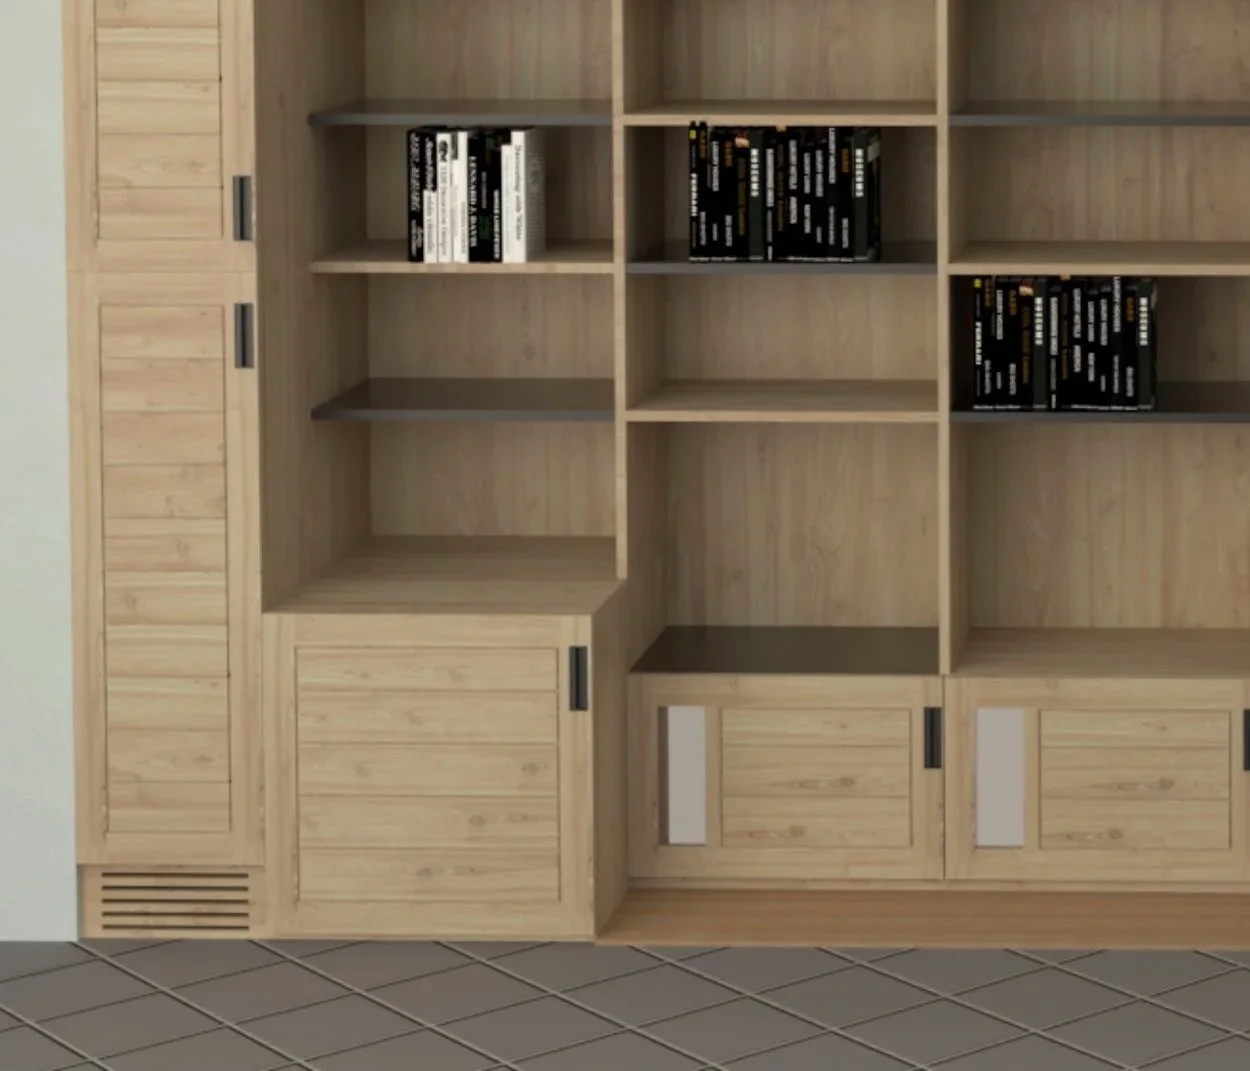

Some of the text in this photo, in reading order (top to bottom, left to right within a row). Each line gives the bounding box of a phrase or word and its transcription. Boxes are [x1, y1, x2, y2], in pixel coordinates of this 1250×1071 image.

[468, 155, 477, 204] LENNARD
[690, 173, 698, 217] FERRARI
[750, 149, 760, 197] MUSEUMS
[855, 149, 864, 197] MUSEUMS
[1034, 297, 1044, 346] MUSEUMS
[1139, 297, 1148, 346] MUSEUMS
